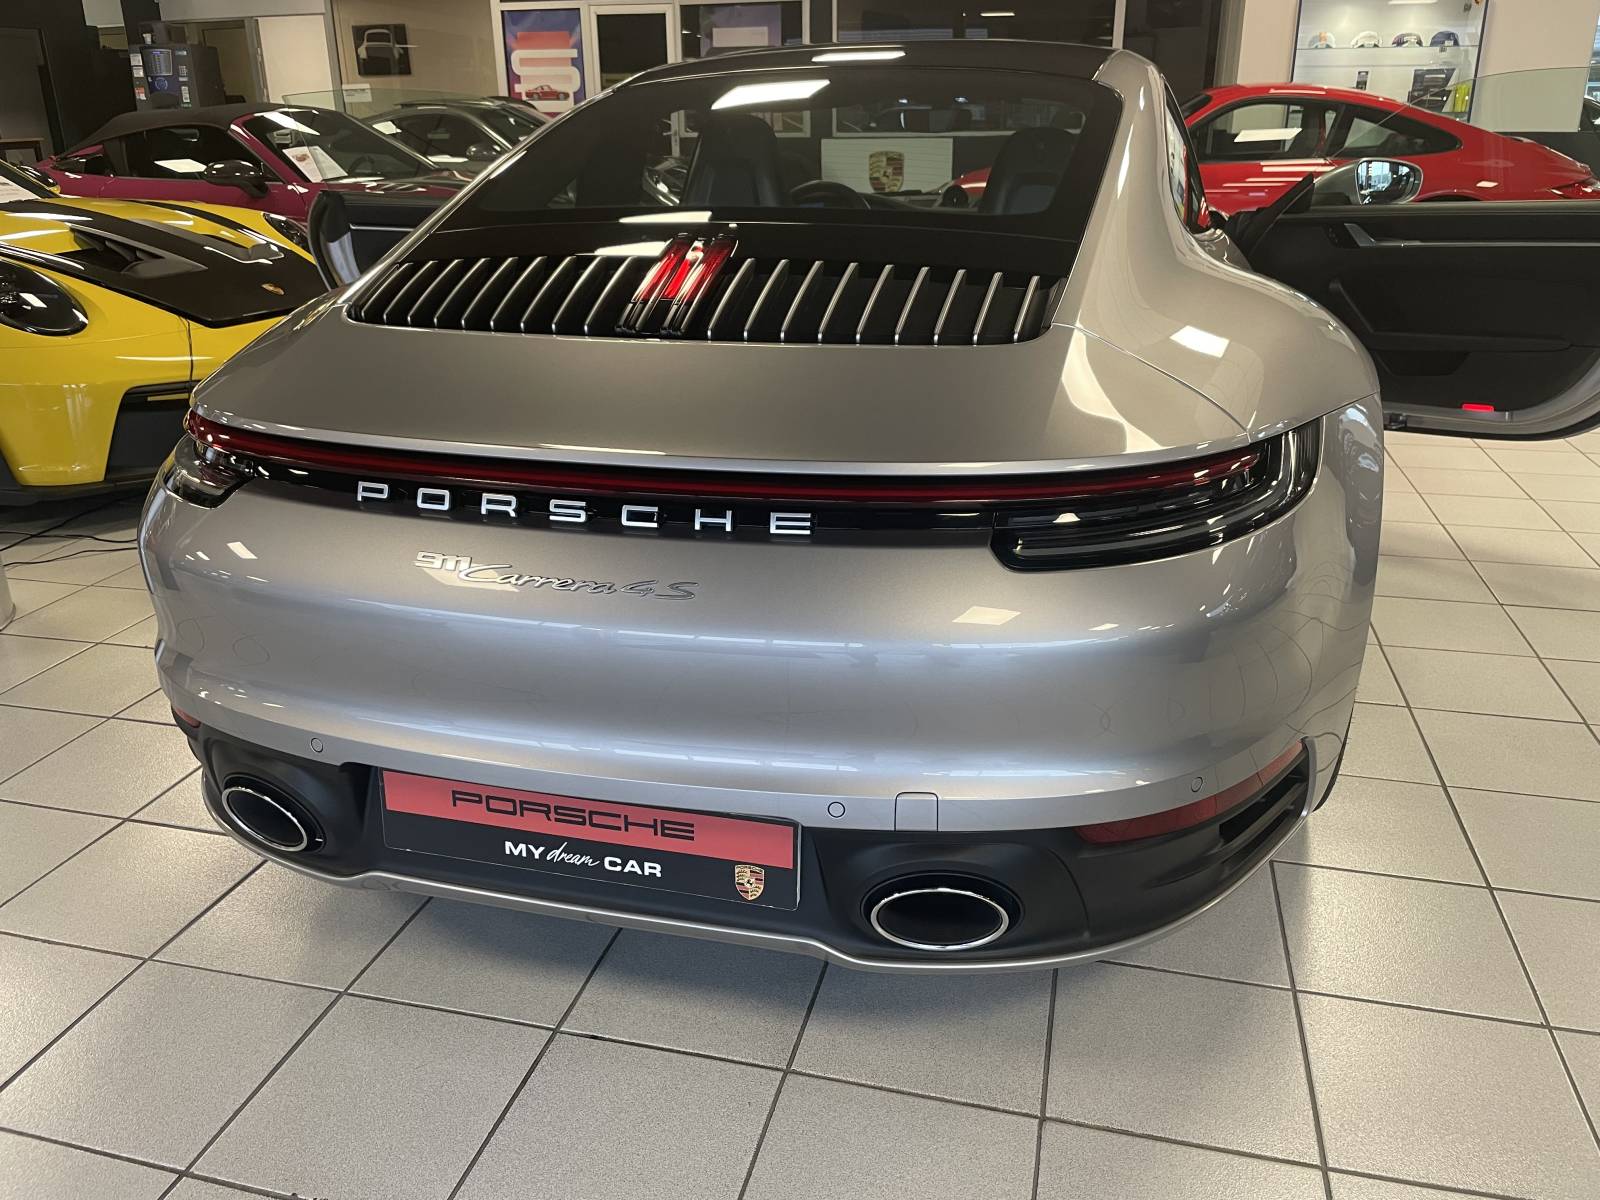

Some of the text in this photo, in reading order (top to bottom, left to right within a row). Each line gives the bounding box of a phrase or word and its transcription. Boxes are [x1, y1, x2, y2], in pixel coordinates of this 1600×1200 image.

[357, 480, 811, 535] PORSCHE
[415, 550, 472, 571] 911
[459, 563, 617, 594] Carrera
[451, 789, 695, 841] PORSCHE
[504, 840, 662, 878] MY dream CAR
